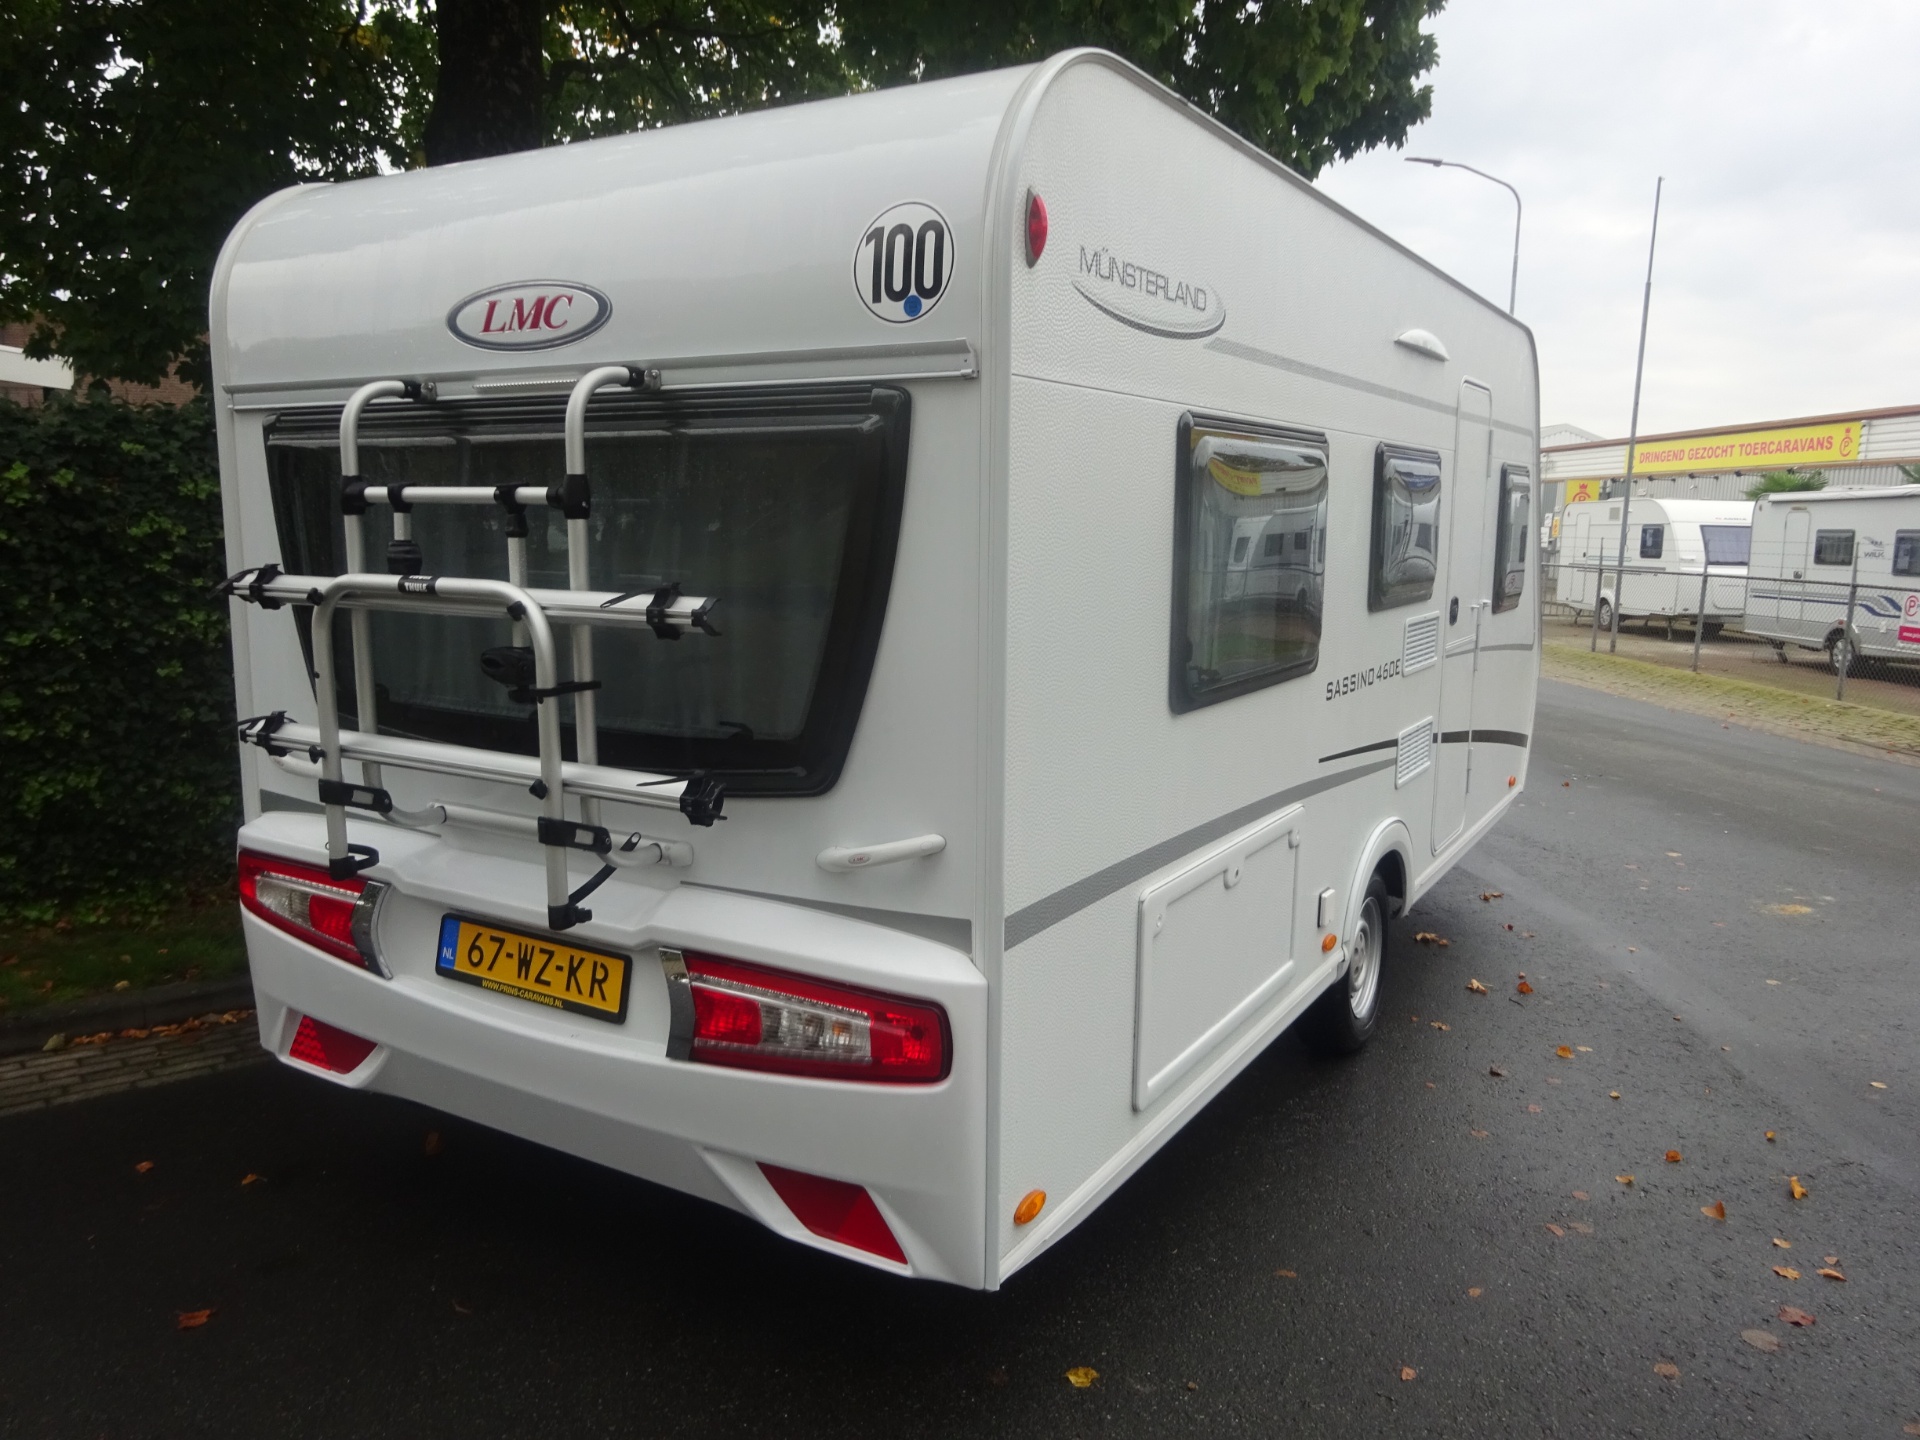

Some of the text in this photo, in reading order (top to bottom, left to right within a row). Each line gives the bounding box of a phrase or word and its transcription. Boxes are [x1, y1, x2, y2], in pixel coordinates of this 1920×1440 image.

[865, 219, 945, 304] 100
[1079, 245, 1208, 312] MÜNSTERLAND
[479, 294, 574, 335] LMC
[1639, 435, 1834, 464] DRINGEND GEZOCHT TOERCARAVANS
[1864, 550, 1885, 558] WILK
[404, 582, 428, 592] THULE
[1326, 667, 1375, 701] SASSINO
[442, 946, 454, 960] NL
[467, 932, 610, 1002] 67-WZ-KR
[481, 979, 564, 1009] WWW.PRINS-CARAVANS.NL
